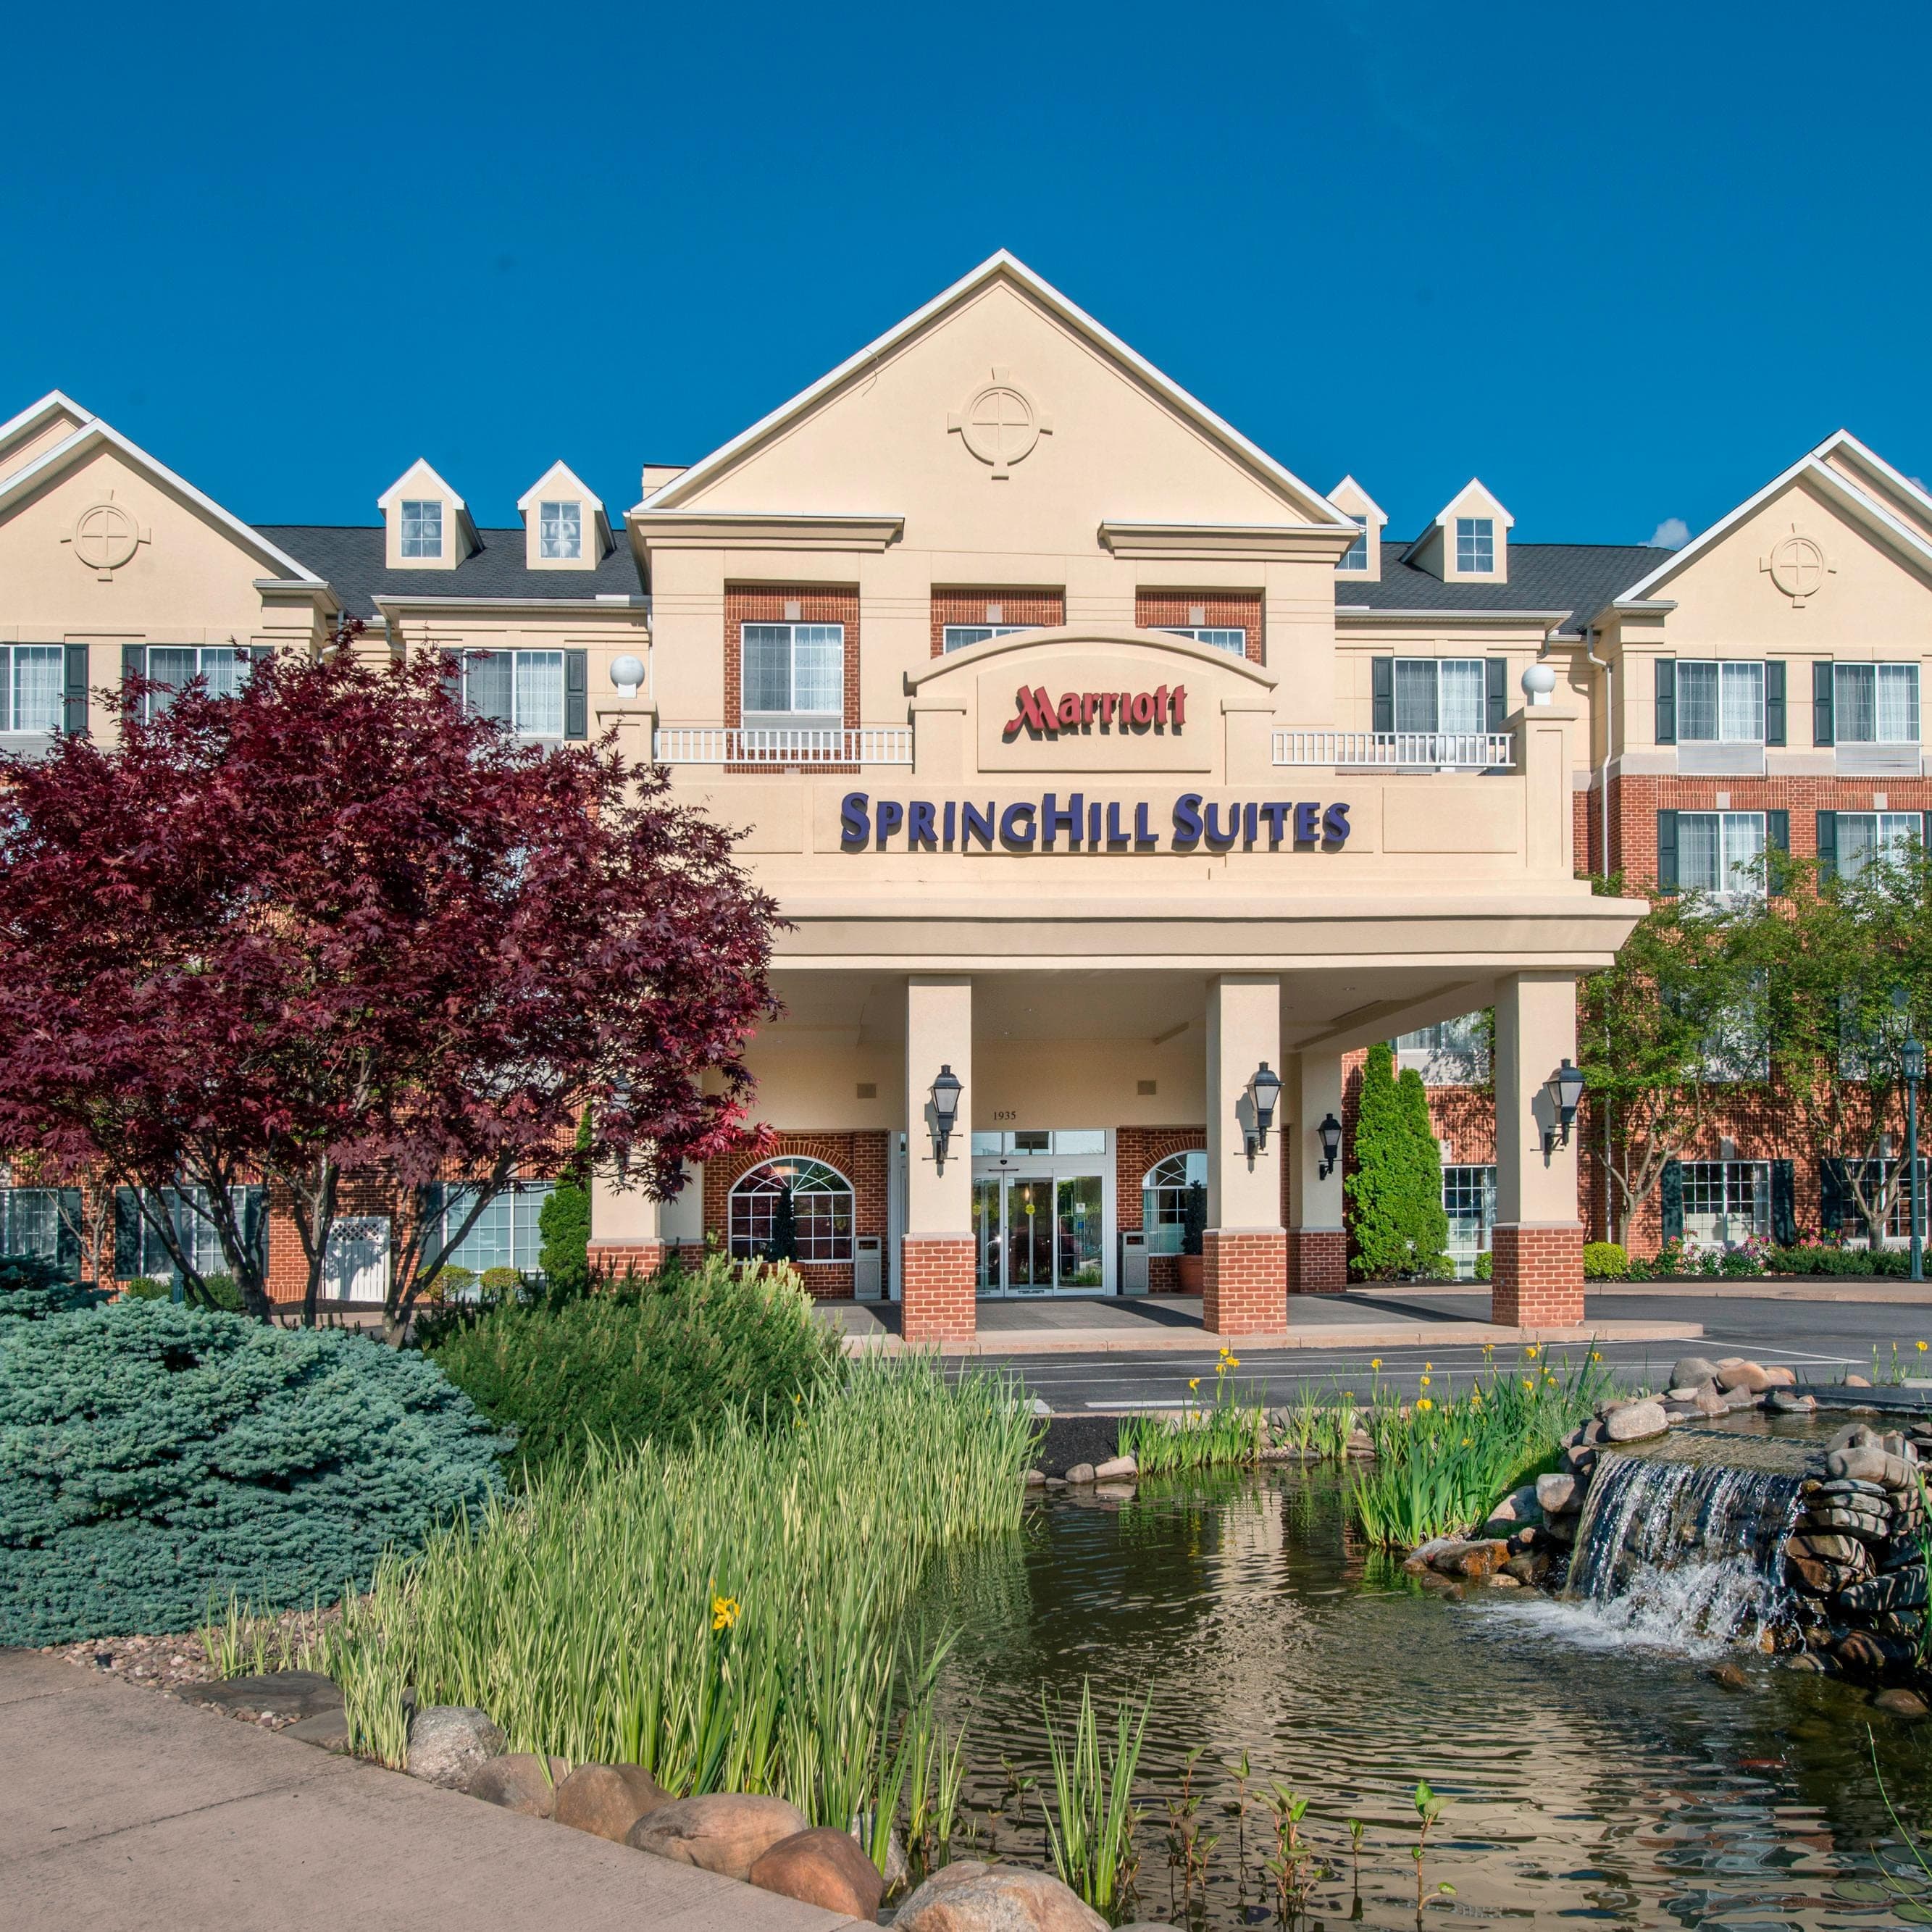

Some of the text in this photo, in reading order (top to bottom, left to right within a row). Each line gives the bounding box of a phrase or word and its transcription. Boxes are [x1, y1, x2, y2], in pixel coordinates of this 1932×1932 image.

[1003, 684, 1188, 733] Marriott
[1173, 793, 1352, 843] SUITES
[993, 1111, 1016, 1121] 1935
